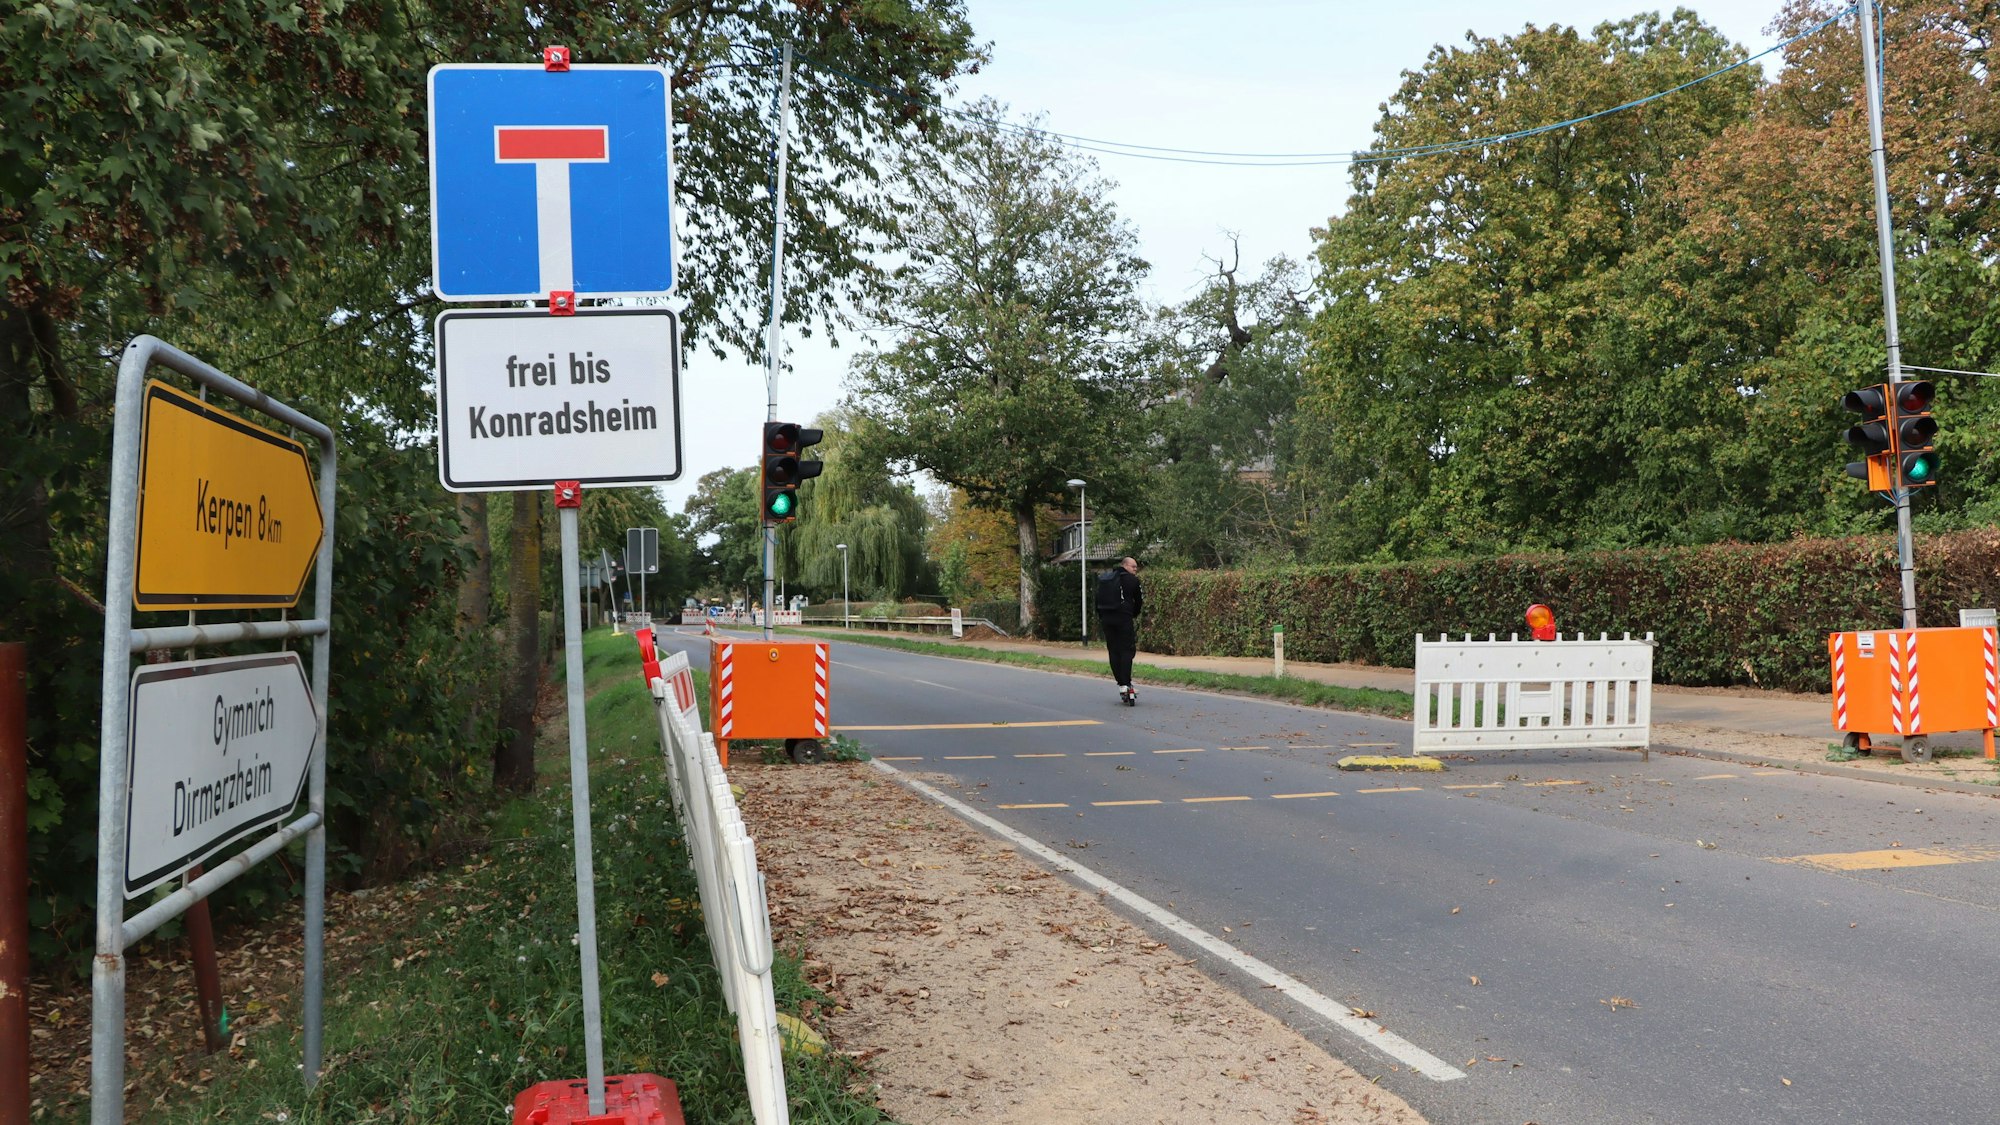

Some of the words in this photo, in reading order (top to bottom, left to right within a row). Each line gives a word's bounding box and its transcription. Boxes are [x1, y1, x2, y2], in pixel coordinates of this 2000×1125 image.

[506, 352, 557, 388] frei
[569, 351, 611, 385] bis
[469, 398, 657, 440] Konradsheim
[196, 477, 253, 550] Kerpen
[213, 686, 274, 756] Gymnich
[173, 753, 272, 838] Dirmerzheim
